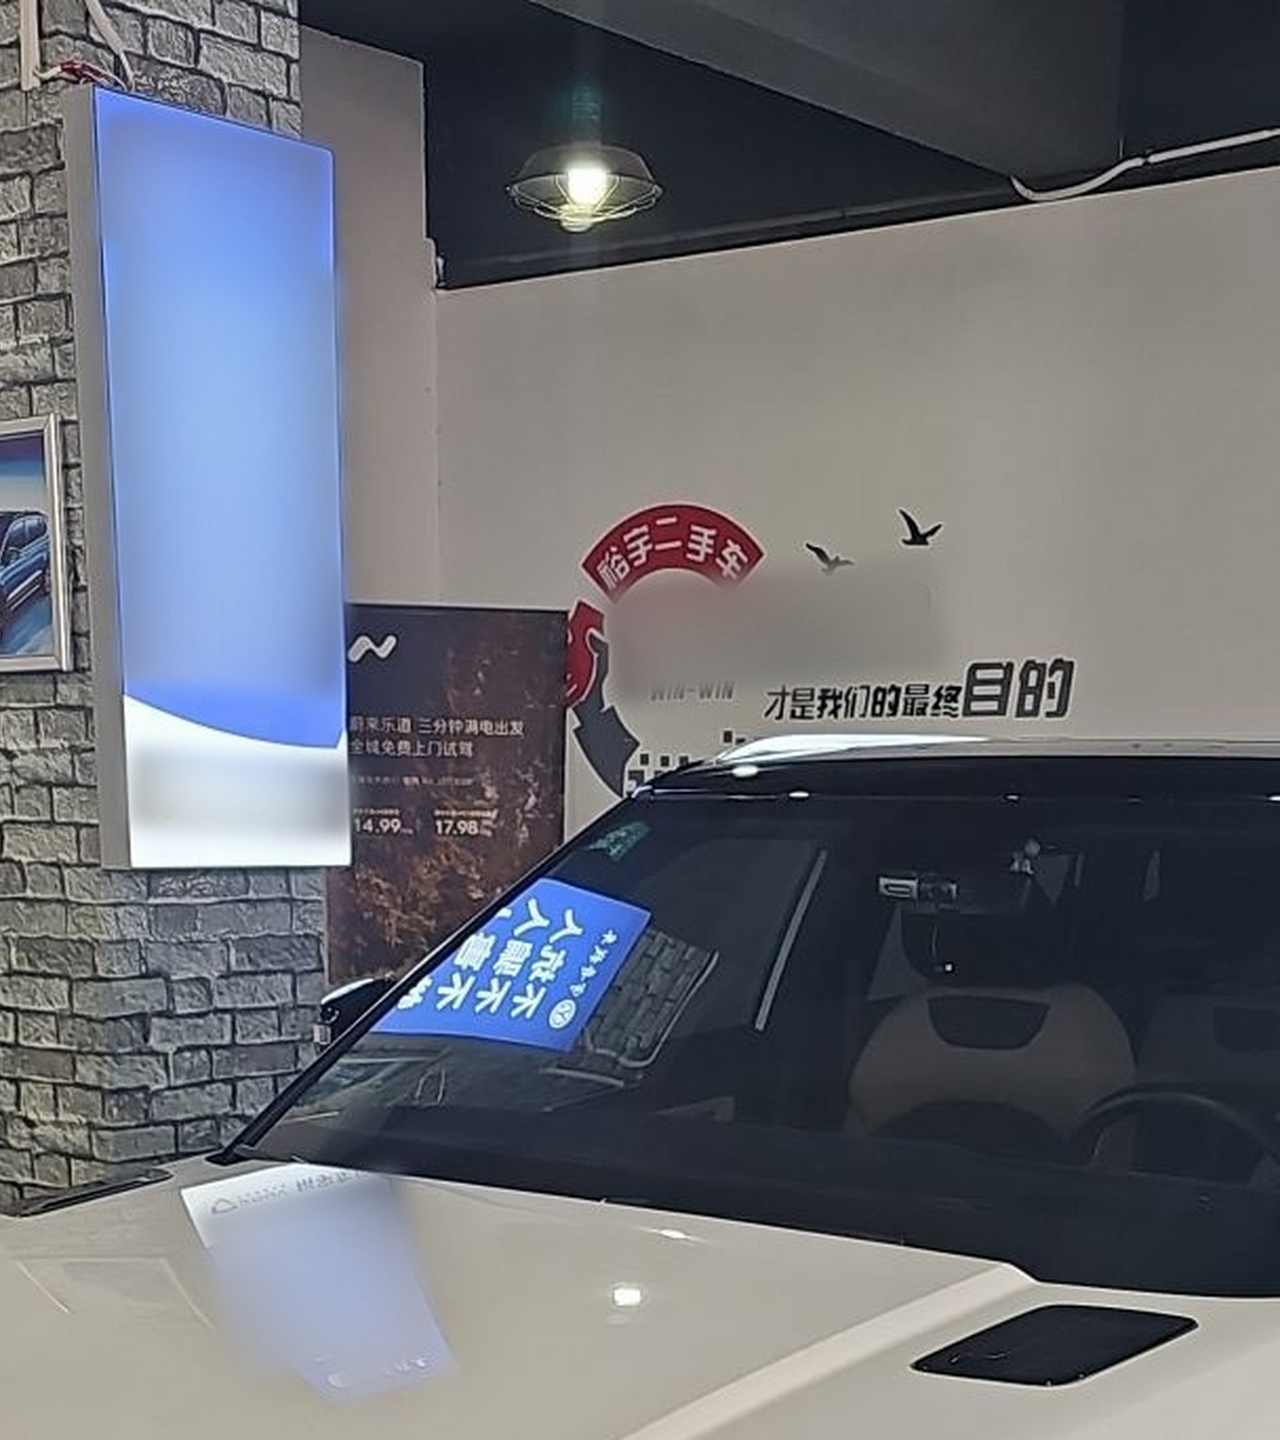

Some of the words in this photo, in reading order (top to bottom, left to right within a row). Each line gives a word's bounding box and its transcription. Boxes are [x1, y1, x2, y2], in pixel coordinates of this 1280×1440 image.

[596, 516, 749, 590] 裕宇二手车
[764, 657, 1075, 720] 才是我们的最终目的
[354, 817, 401, 834] 14.99
[435, 819, 479, 836] 17.98
